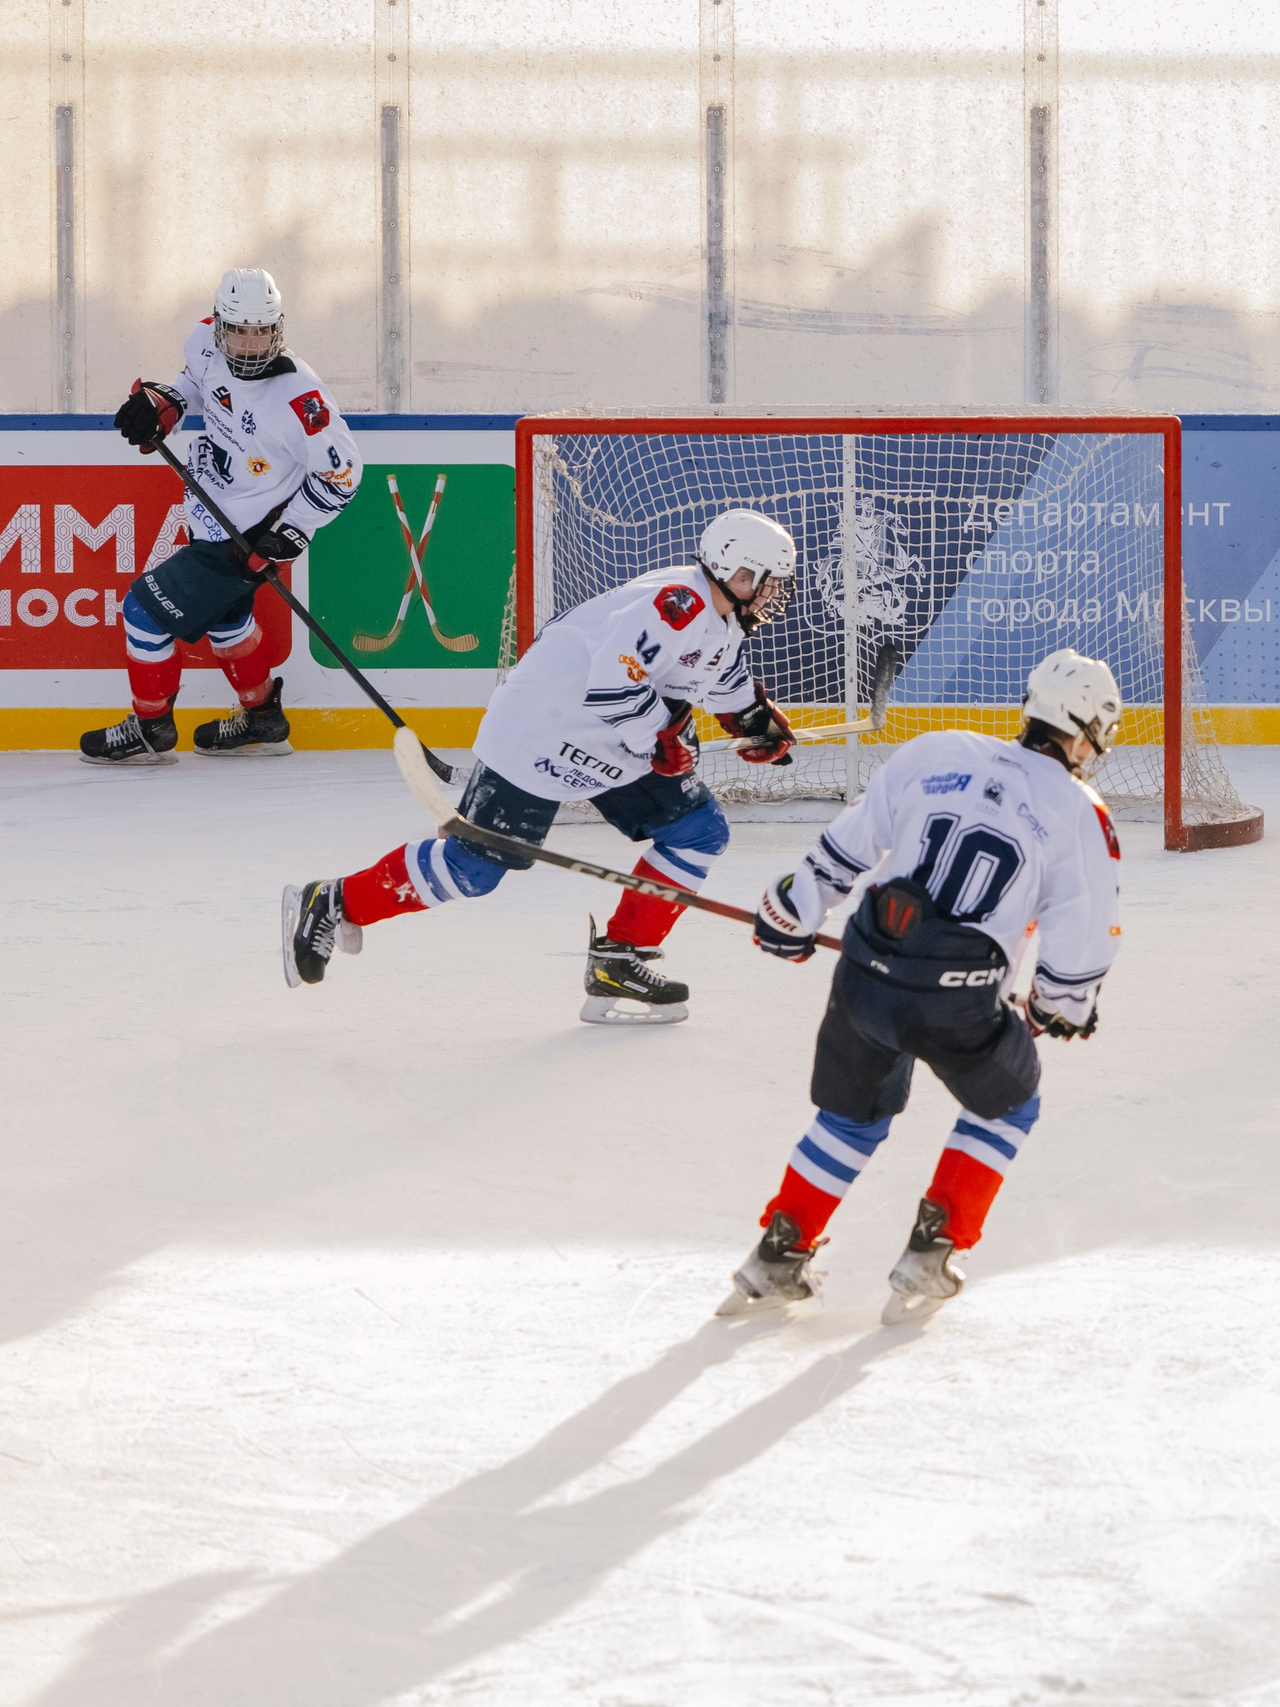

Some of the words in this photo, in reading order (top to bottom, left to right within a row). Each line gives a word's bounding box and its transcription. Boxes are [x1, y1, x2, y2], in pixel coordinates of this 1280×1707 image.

[327, 445, 341, 469] 8
[963, 495, 1231, 535] Департамнт
[965, 550, 1100, 583] спорта
[143, 574, 184, 619] BAUER
[966, 598, 1101, 632] города
[569, 861, 680, 902] CCM
[908, 812, 1026, 923] 10
[938, 965, 1007, 987] CCM
